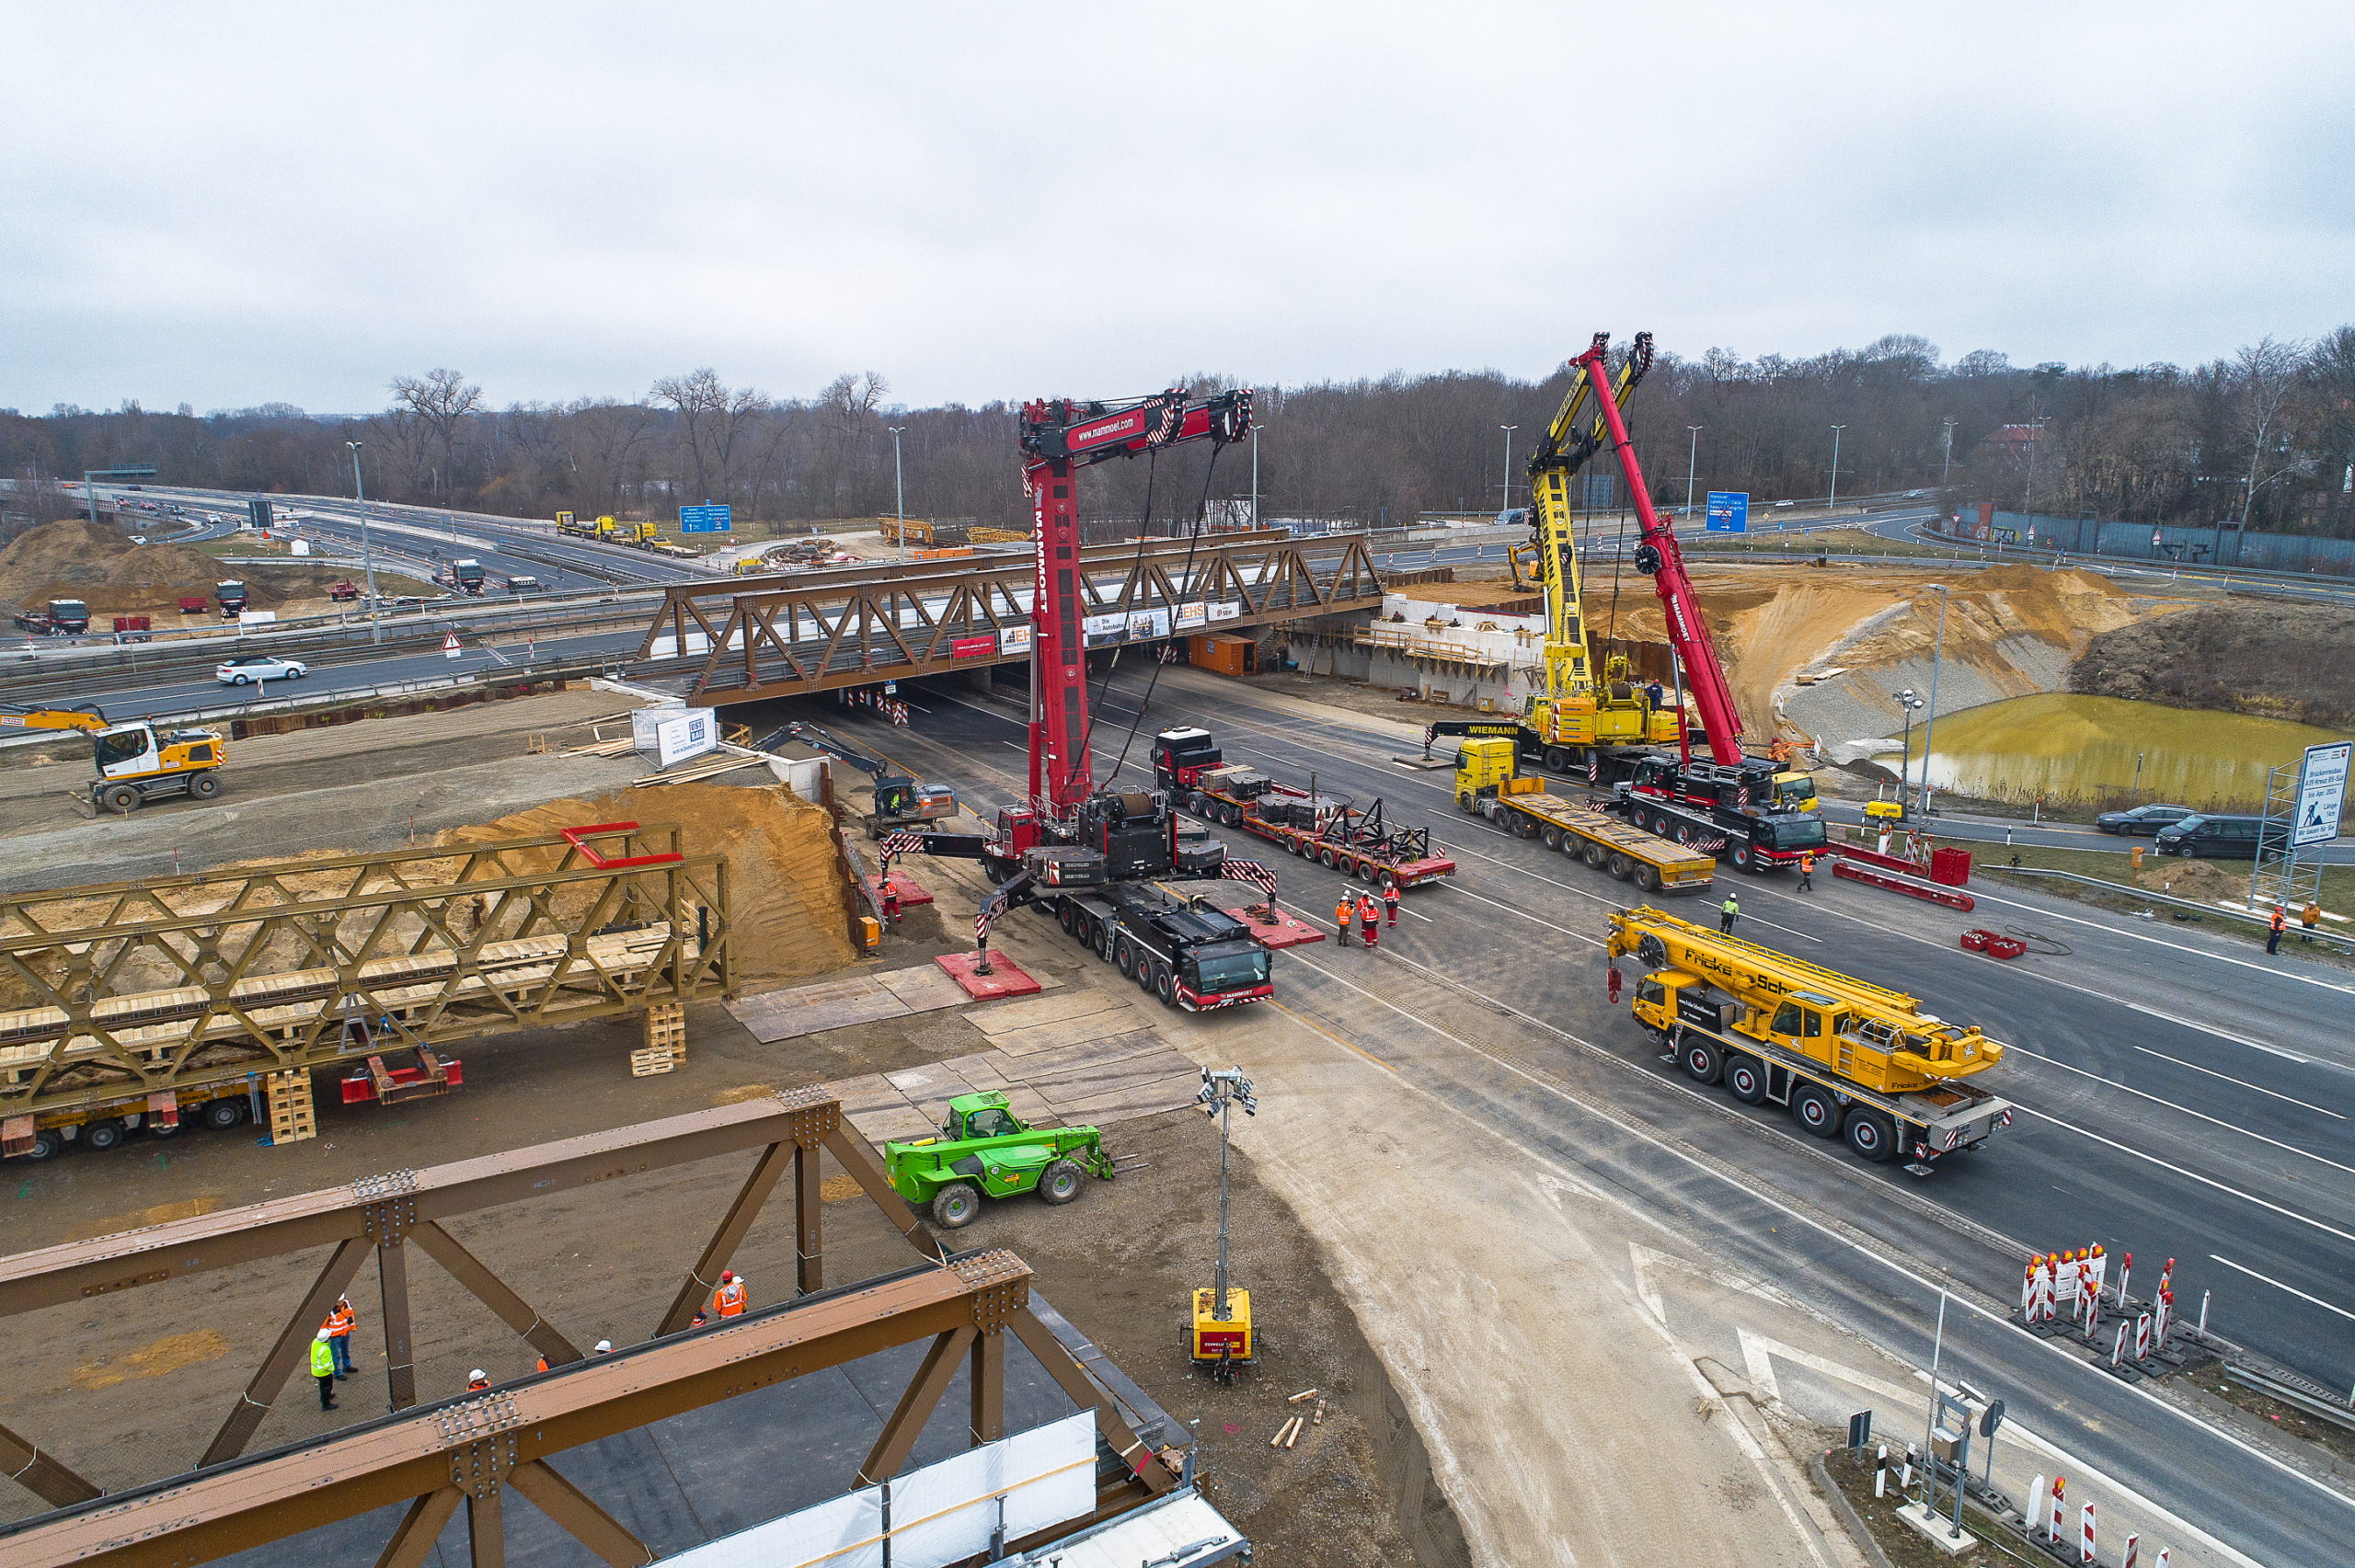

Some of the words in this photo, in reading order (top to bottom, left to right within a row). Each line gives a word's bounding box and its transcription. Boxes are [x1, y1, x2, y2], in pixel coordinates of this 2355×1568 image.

[1078, 418, 1134, 441] www.mammoet.com
[1539, 493, 1555, 581] WIEMANN
[1035, 510, 1048, 613] MAMMOET
[1183, 604, 1204, 618] EHS
[1102, 623, 1124, 632] Autobahn
[1673, 603, 1691, 642] MAMMOET
[1016, 629, 1030, 643] EH
[1469, 726, 1519, 735] WIEMANN
[2324, 803, 2338, 811] Länge
[1684, 947, 1732, 977] Fricke
[1226, 990, 1253, 998] MAMMOET
[1891, 1081, 1918, 1090] Fricke
